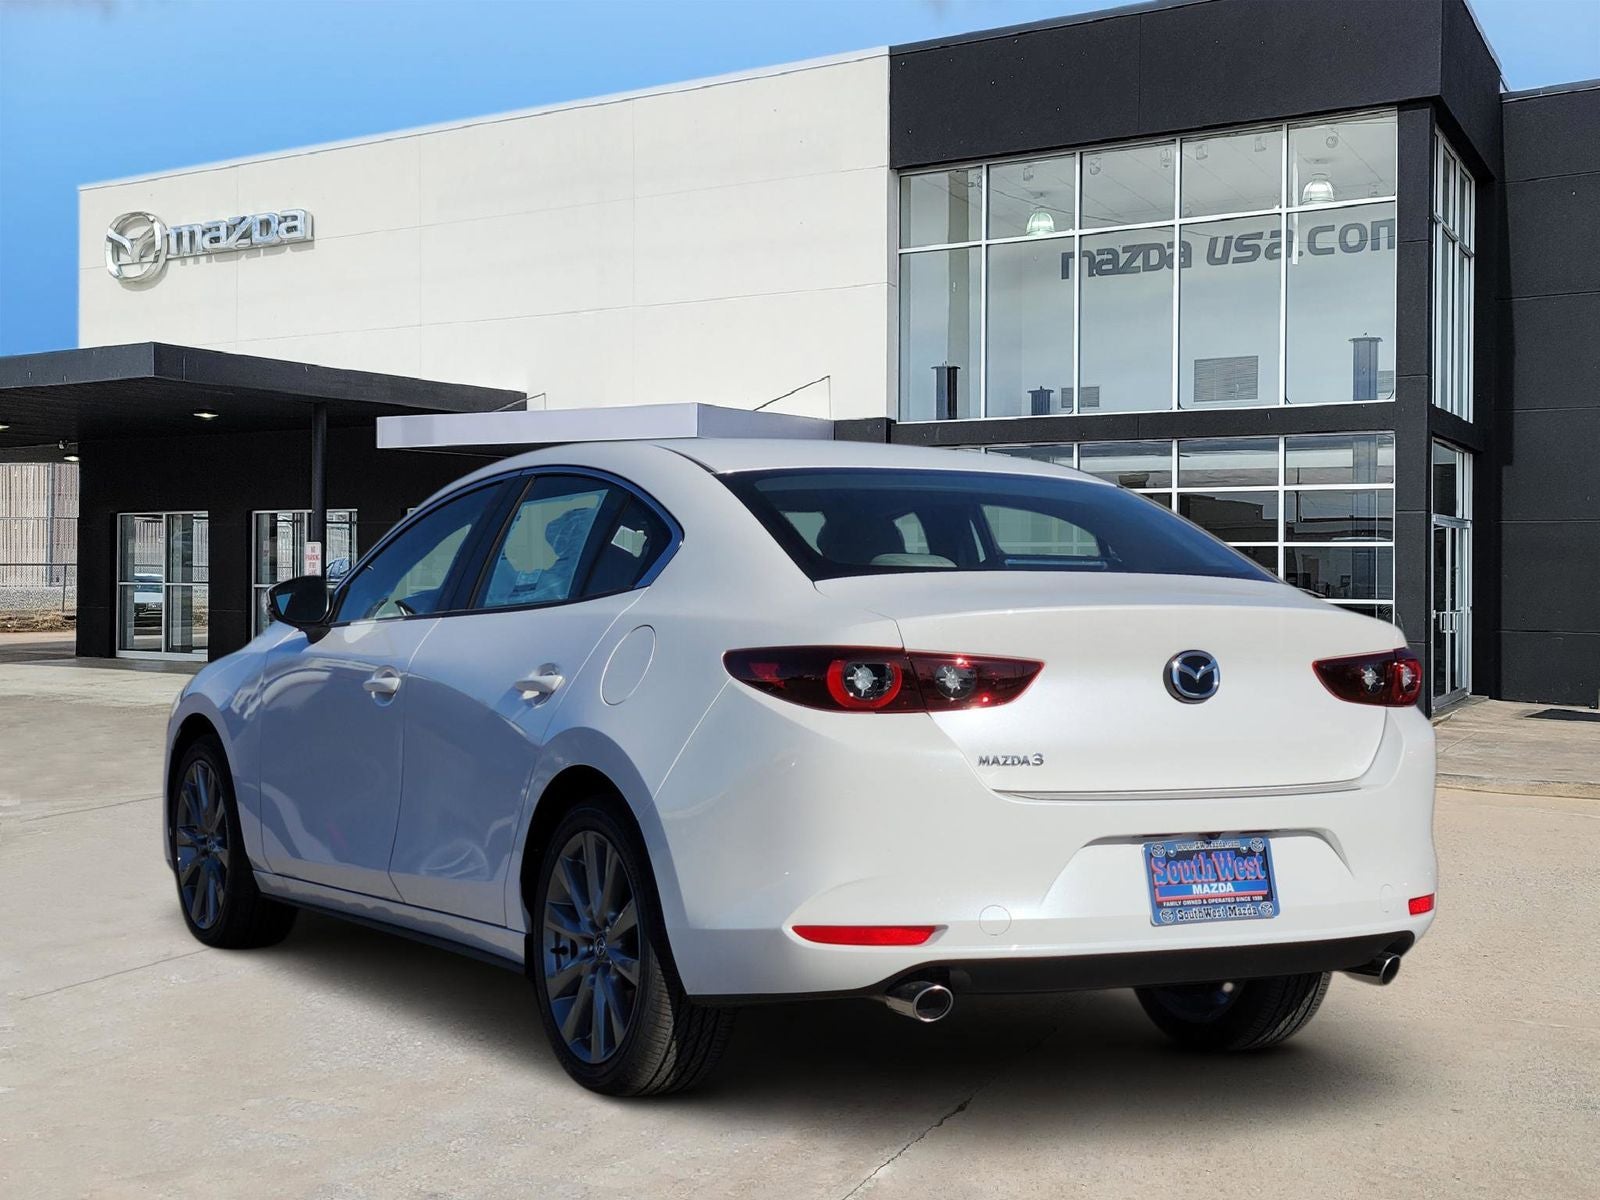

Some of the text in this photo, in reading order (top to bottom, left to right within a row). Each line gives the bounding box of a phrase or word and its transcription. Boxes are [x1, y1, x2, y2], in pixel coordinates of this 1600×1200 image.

[167, 208, 314, 257] mazda
[1061, 240, 1193, 280] mazda
[978, 753, 1044, 766] MAZDA3
[1151, 850, 1266, 886] SouthWest
[1192, 882, 1235, 895] MAZDA
[1208, 897, 1235, 905] OPERATED
[1177, 904, 1259, 921] SouthWest Mazda
